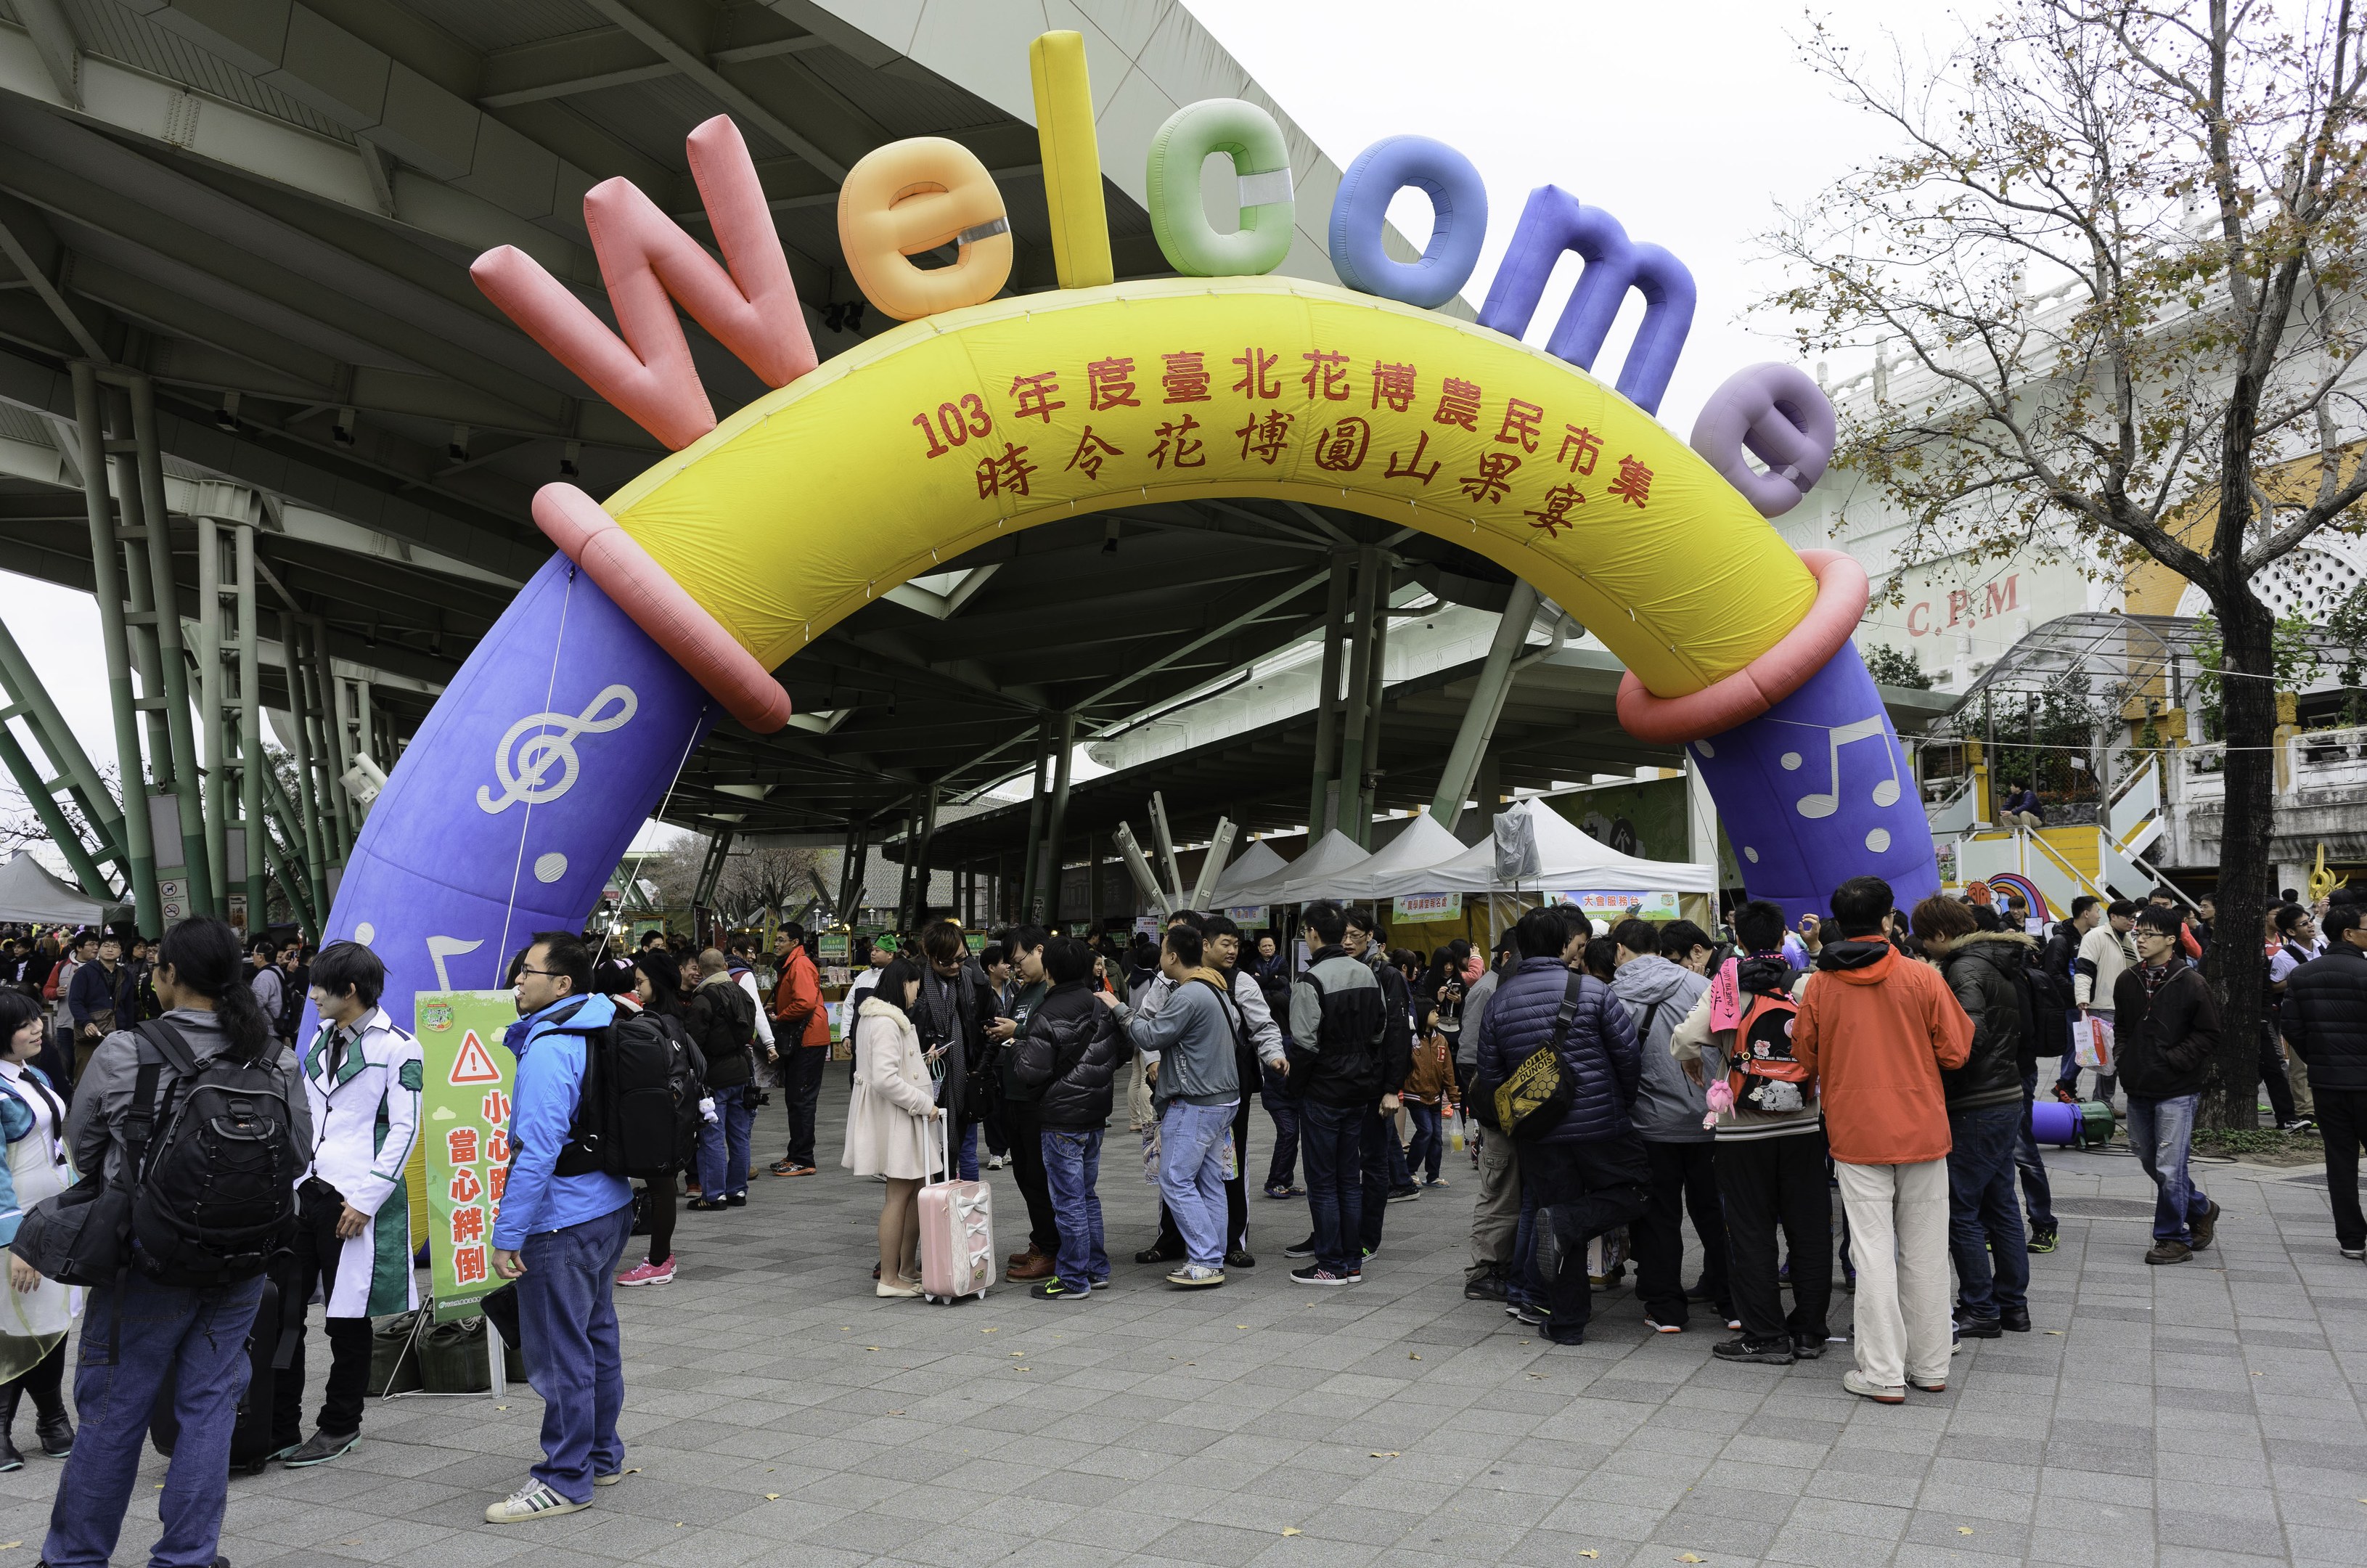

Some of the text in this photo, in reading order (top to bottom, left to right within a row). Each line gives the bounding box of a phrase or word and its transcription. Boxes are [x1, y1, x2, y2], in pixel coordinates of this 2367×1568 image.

[470, 29, 1836, 517] Welcome
[1584, 895, 1640, 907] 大會服務台
[1520, 1055, 1553, 1083] DUNOIS
[449, 1129, 486, 1283] 當心絆倒
[484, 1092, 512, 1223] 小心路
